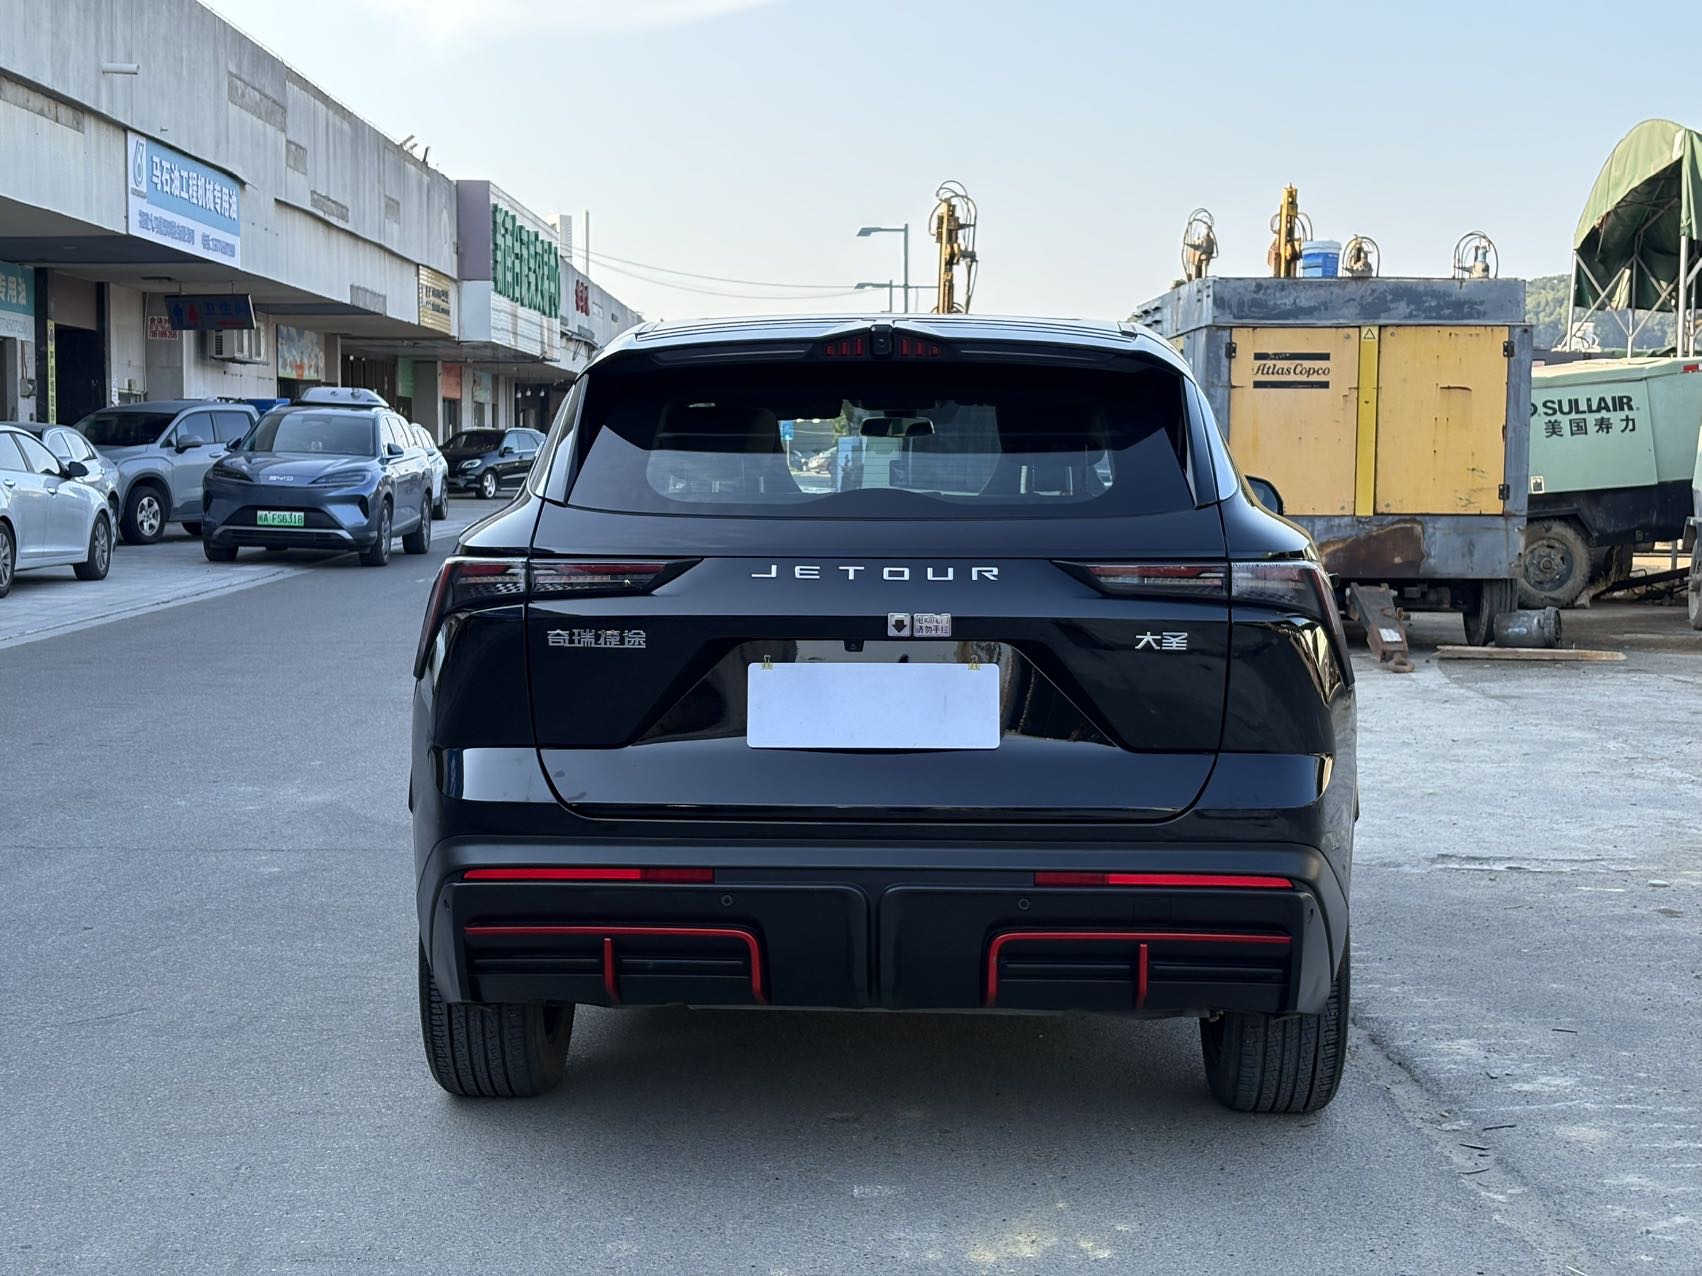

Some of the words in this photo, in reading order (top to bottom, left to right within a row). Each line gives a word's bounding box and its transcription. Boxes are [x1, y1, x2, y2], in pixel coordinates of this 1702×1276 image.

[151, 154, 238, 222] 马石油工程机械专用油
[1252, 363, 1292, 376] Atlas
[1293, 363, 1331, 378] Copco
[1542, 395, 1634, 416] SULLAIR
[1544, 415, 1637, 438] 美国寿力
[751, 564, 999, 581] JETOUR
[546, 628, 647, 649] 奇瑞捷途
[915, 625, 949, 634] 请勿手拉
[1134, 631, 1188, 651] 大圣
